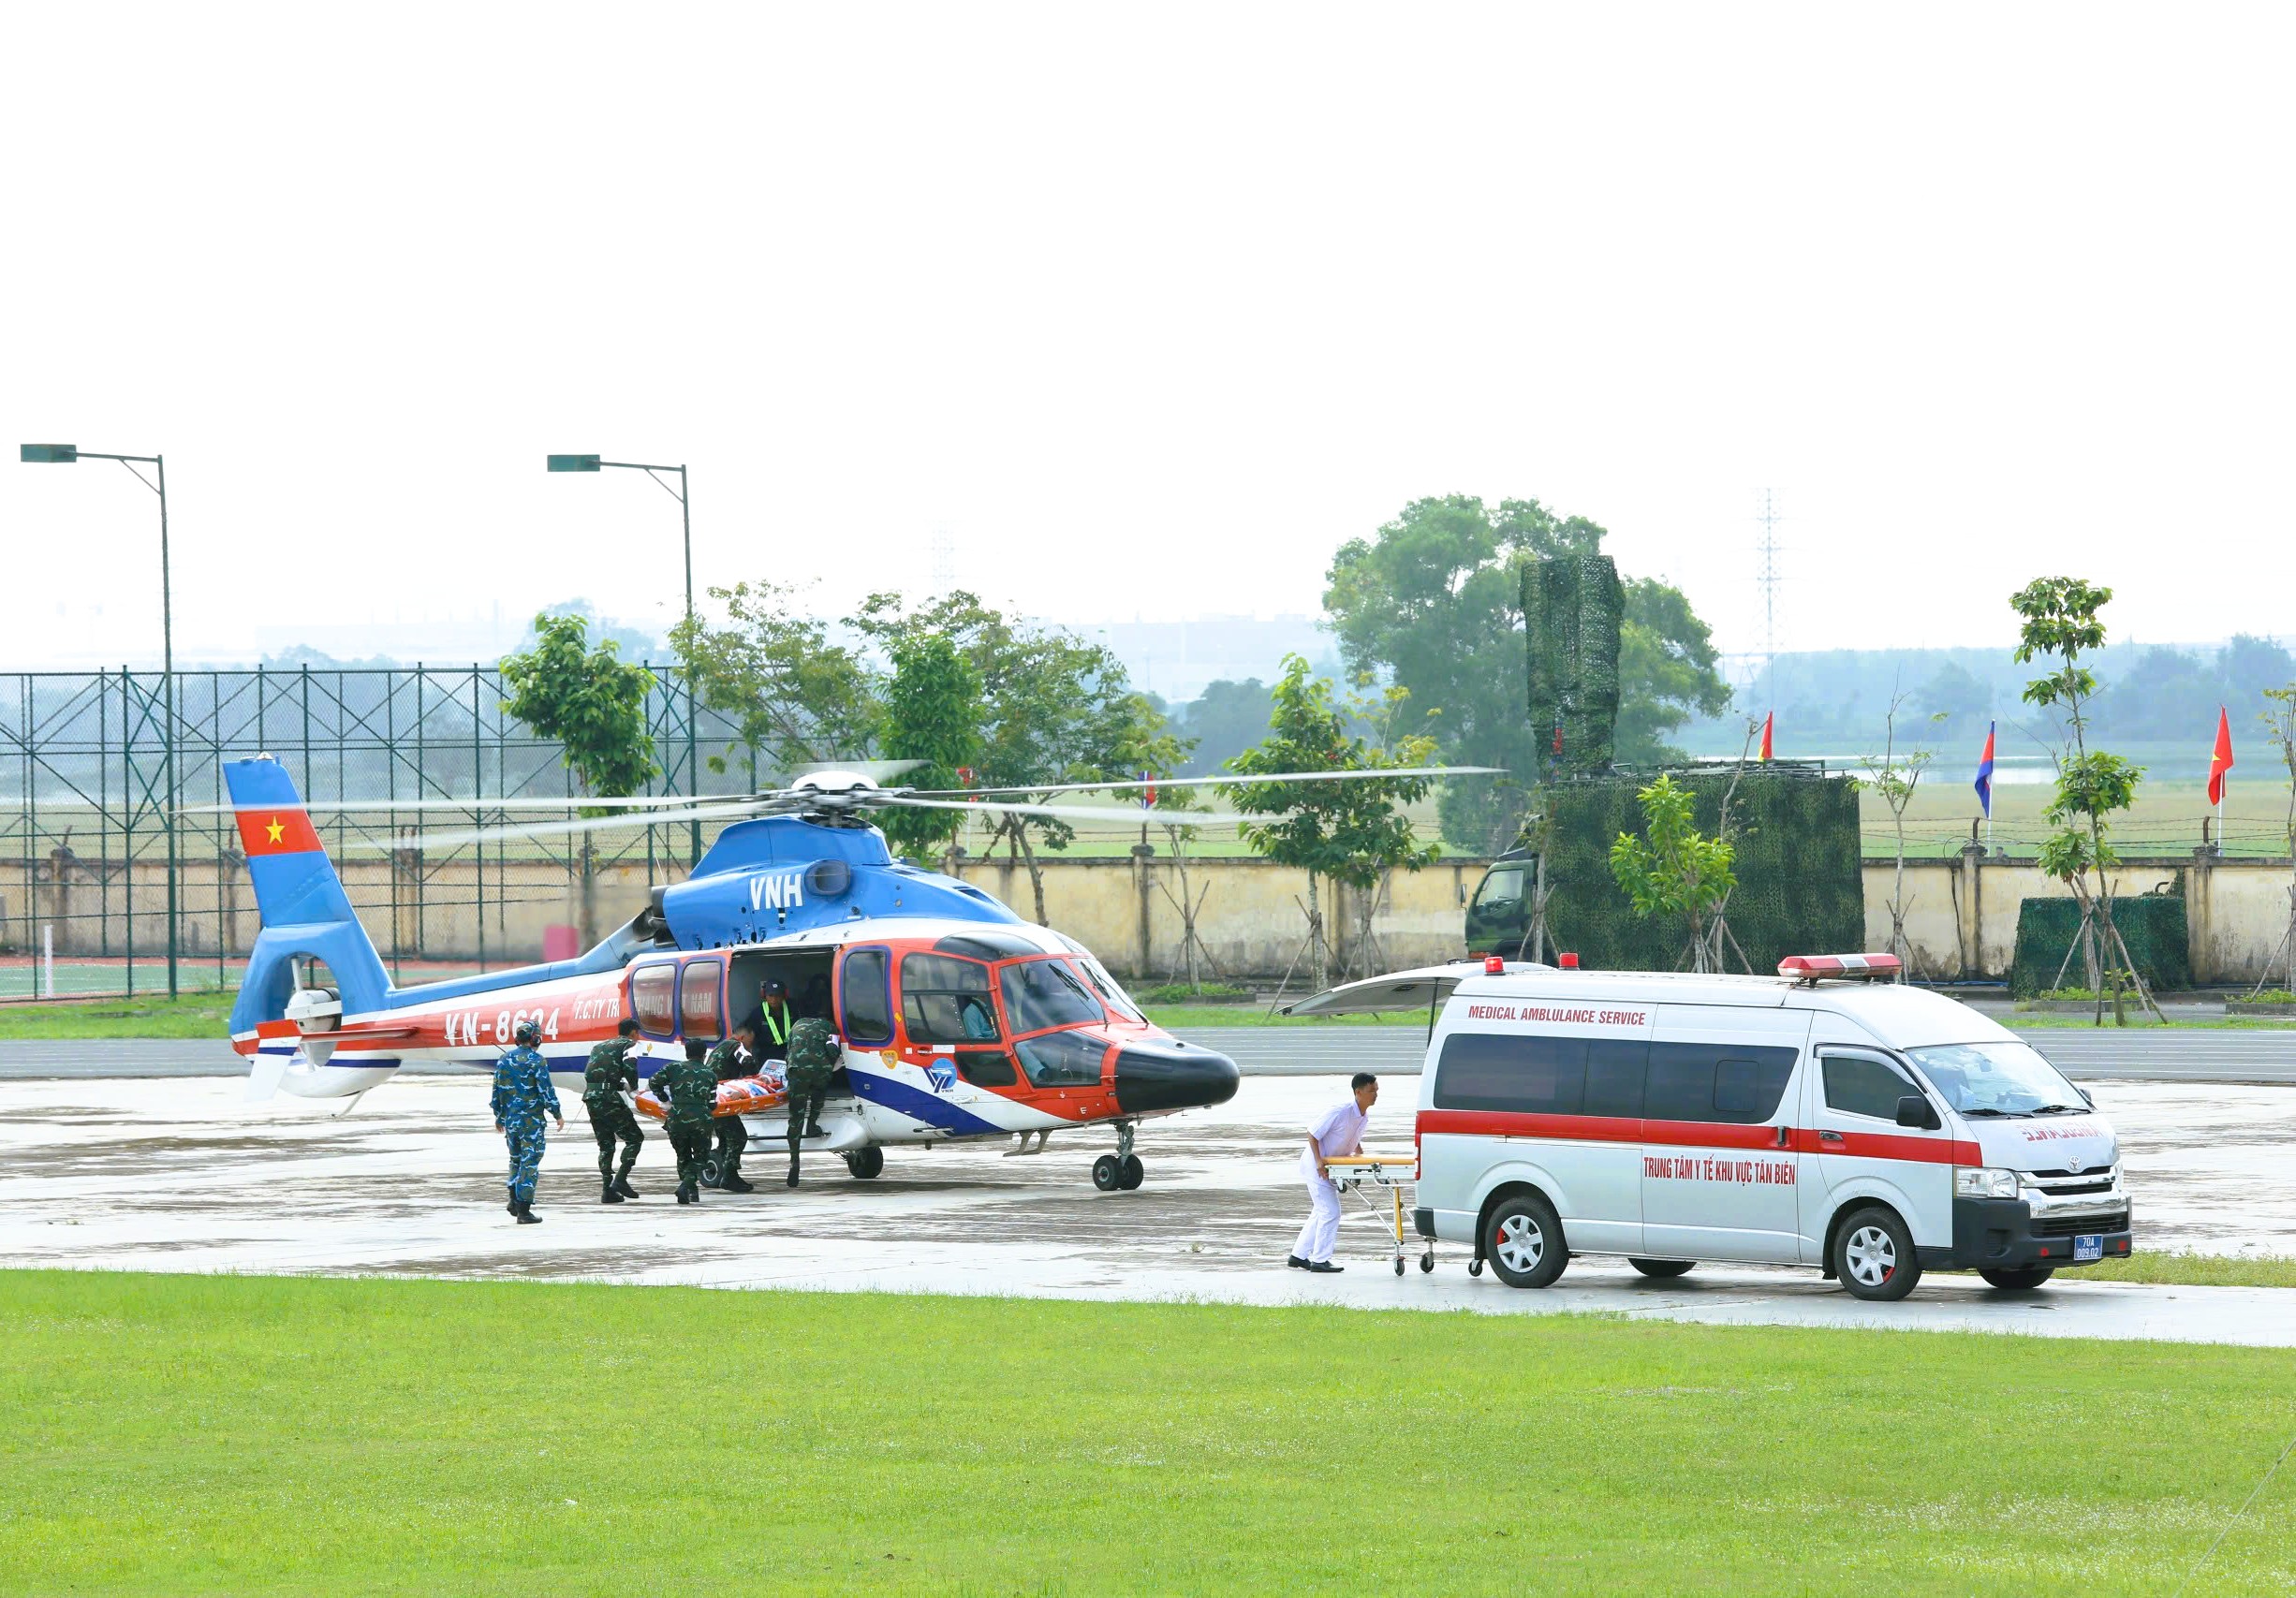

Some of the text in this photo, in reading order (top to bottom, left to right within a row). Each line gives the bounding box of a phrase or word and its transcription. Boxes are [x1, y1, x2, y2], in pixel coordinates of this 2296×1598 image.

[750, 873, 802, 910] VNH
[691, 992, 712, 1014] NAM
[1468, 1005, 1646, 1026] MEDICAL AMBLULANCE SERVICE
[1644, 1153, 1796, 1187] TRUNG TÂM Y TẾ KHU VỰC TÂN BIÊN
[2077, 1248, 2098, 1258] 009.02
[2083, 1237, 2095, 1248] 70A
